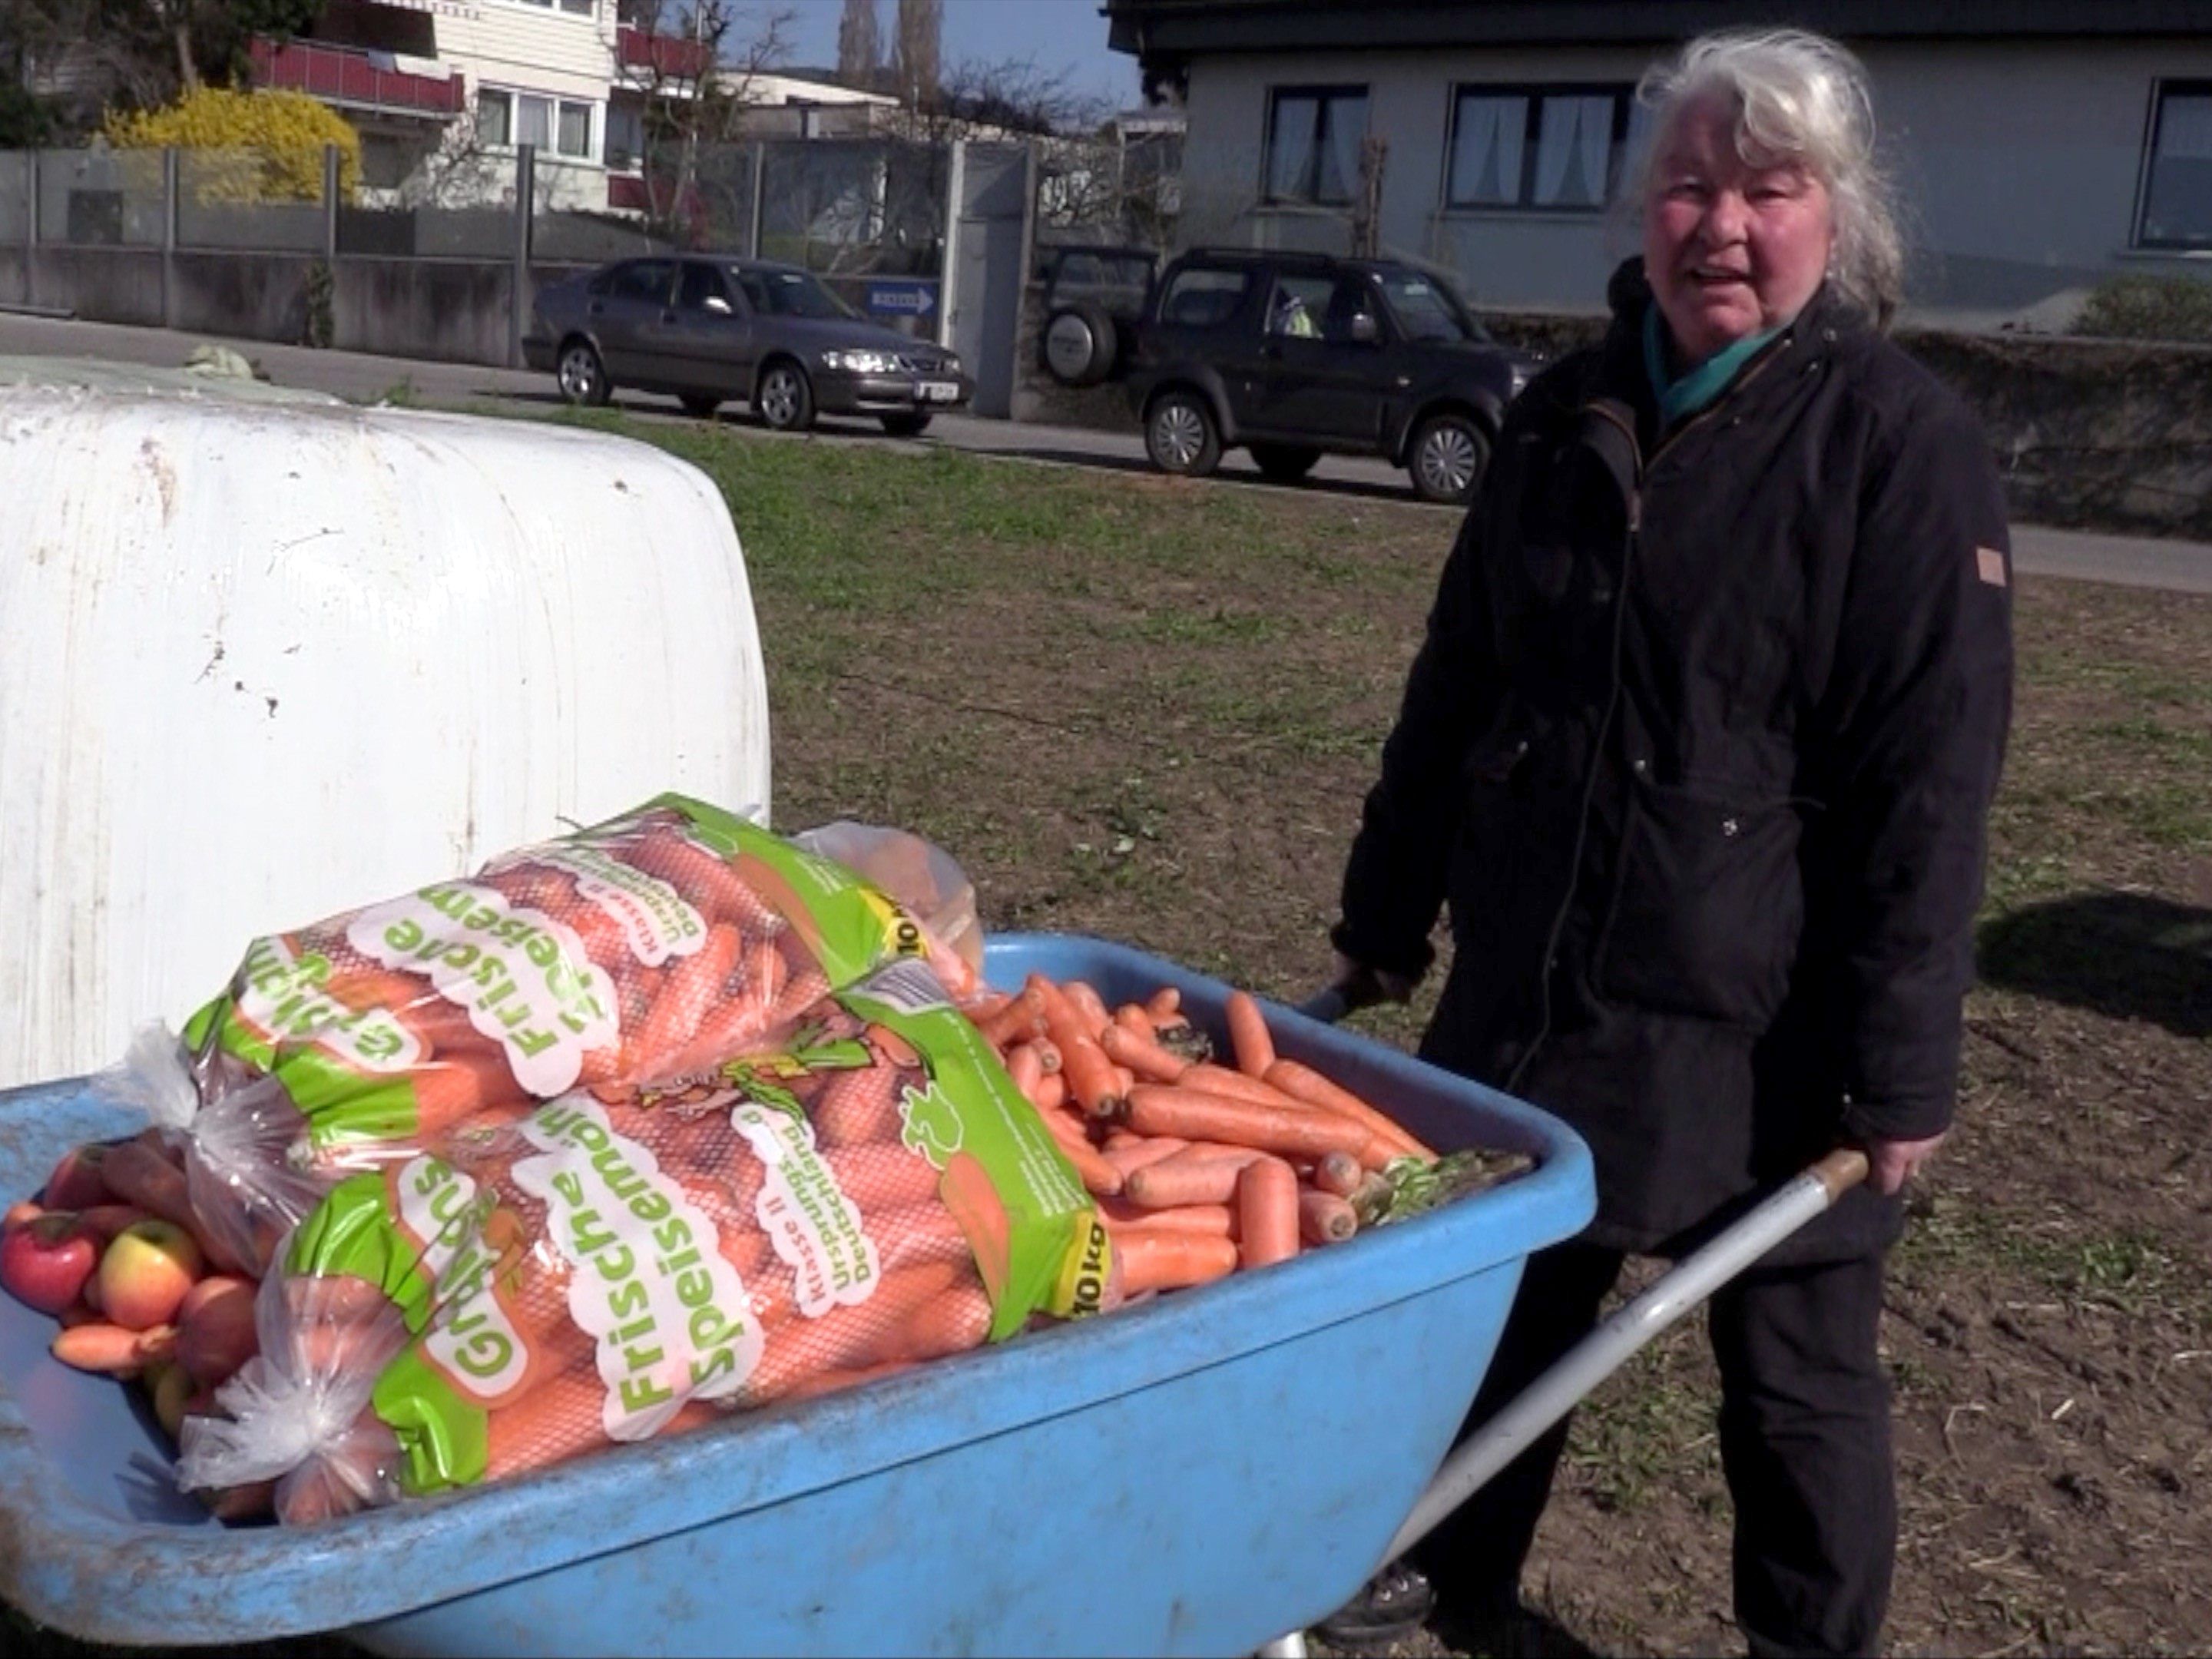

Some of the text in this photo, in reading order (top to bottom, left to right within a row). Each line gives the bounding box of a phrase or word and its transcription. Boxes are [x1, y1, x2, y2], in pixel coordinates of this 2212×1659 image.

[783, 1126, 869, 1283] Deutschland
[785, 1220, 826, 1303] Klasse
[551, 1171, 673, 1413] Frische
[1073, 1277, 1102, 1318] 10
